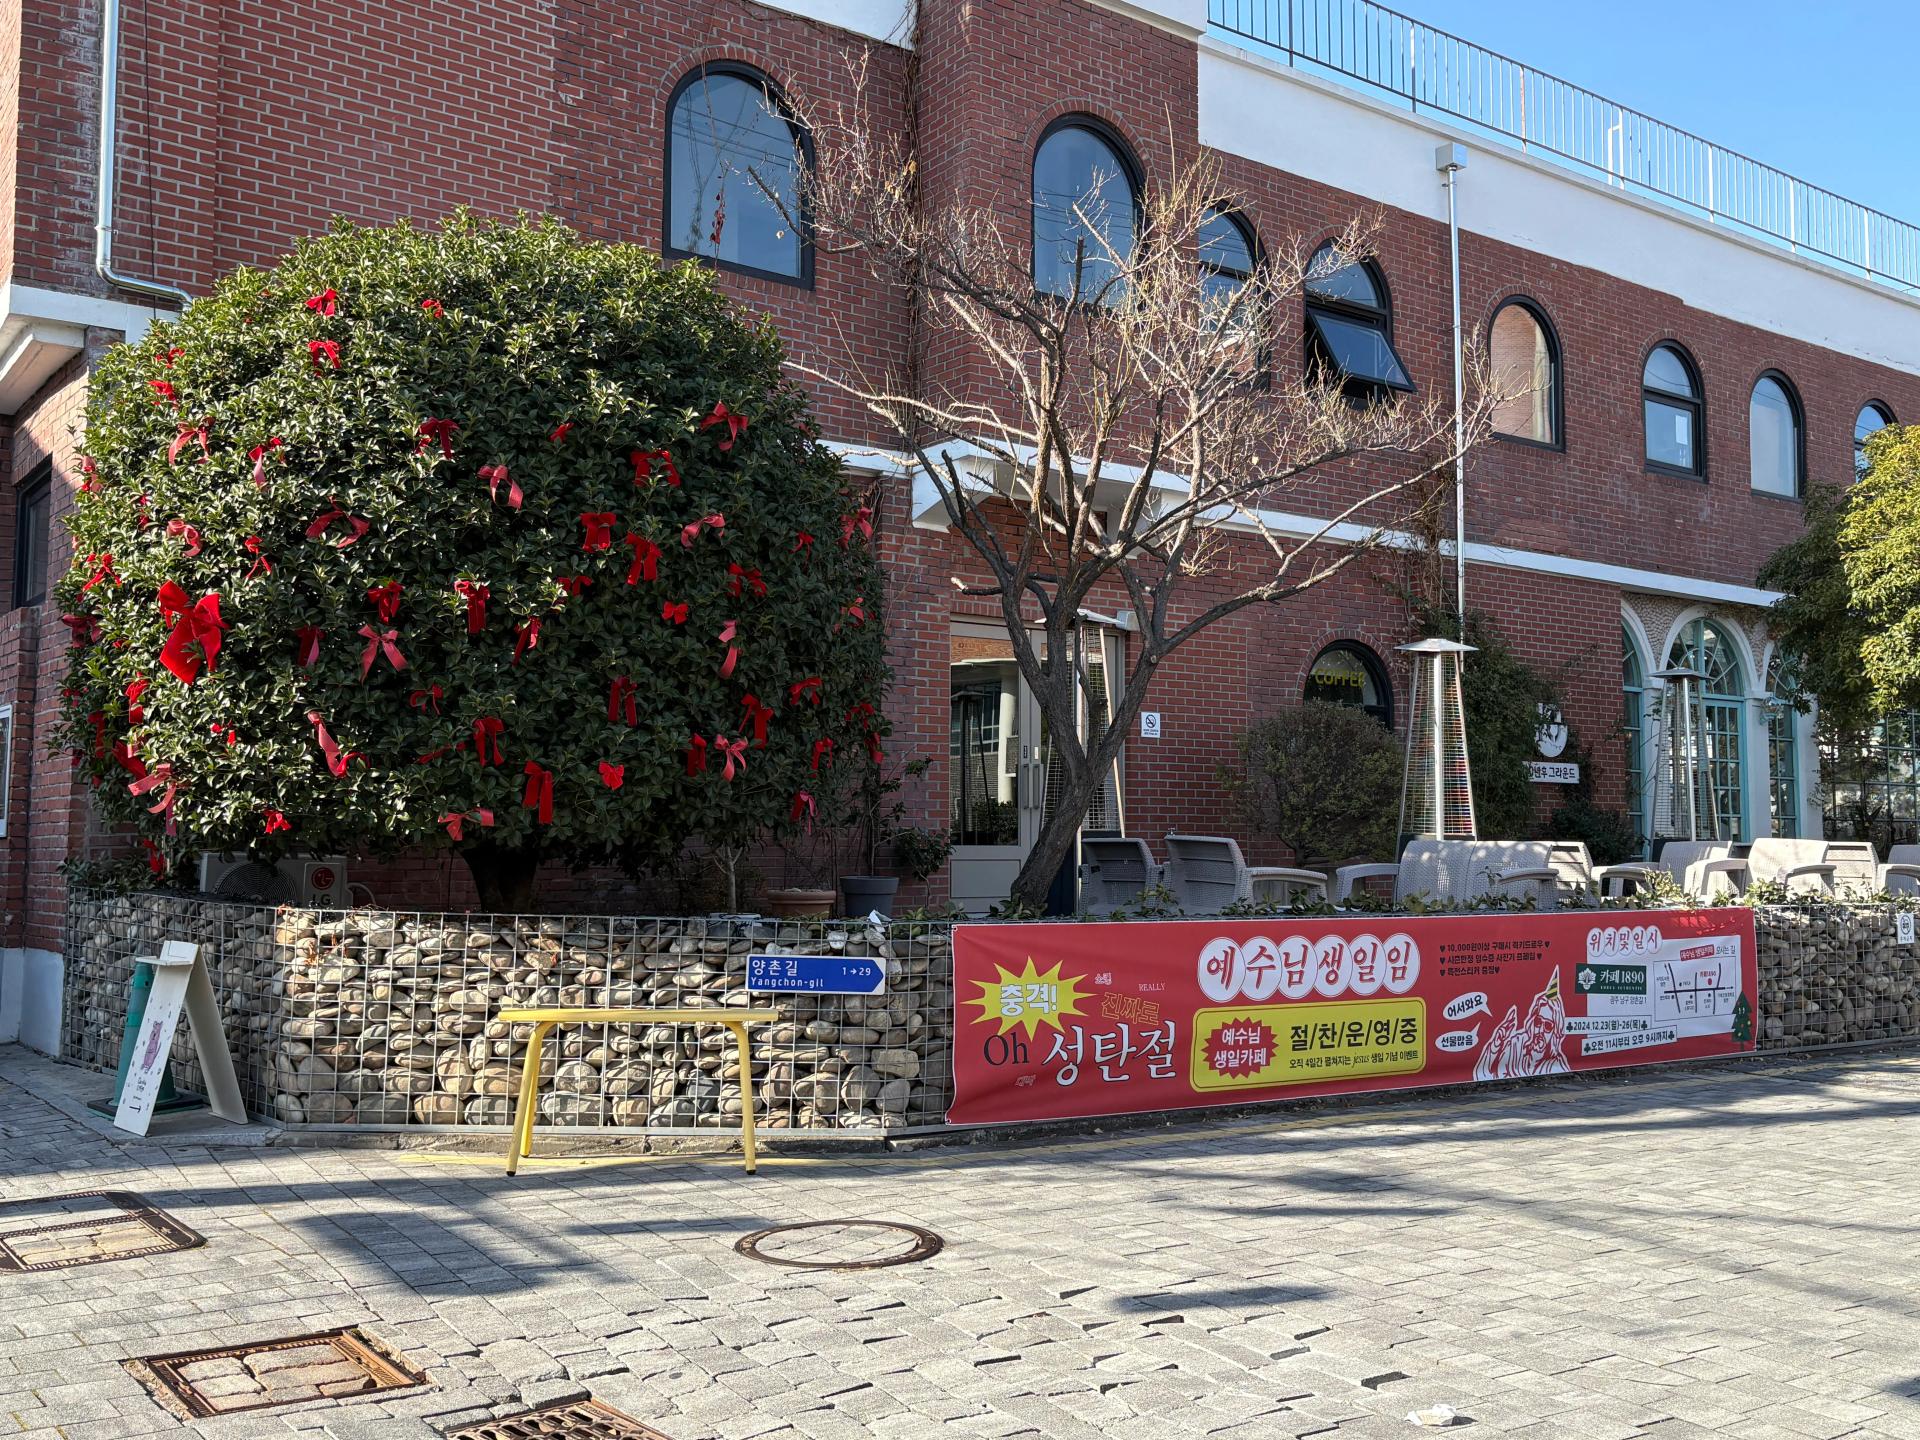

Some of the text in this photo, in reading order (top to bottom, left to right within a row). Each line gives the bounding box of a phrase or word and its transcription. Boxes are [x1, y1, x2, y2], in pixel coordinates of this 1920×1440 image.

[1589, 929, 1659, 953] 위치및일시
[752, 960, 797, 976] 양촌길
[1207, 941, 1410, 991] 예수님생일임
[751, 977, 824, 989] Yangchon-gil
[1138, 983, 1165, 991] REALLY
[1001, 983, 1057, 1017] 충격!
[1101, 991, 1160, 1026] 진짜로
[1447, 994, 1483, 1017] 어서와요
[1221, 1027, 1261, 1046] 예수님
[1290, 1017, 1418, 1052] 절/찬/운/영/중
[1441, 1035, 1474, 1048] 선물많음
[1591, 1041, 1604, 1052] 오전
[1632, 1034, 1644, 1044] 오후
[1646, 1031, 1668, 1043] 9시까지
[984, 1019, 1177, 1087] Oh 성탄절
[1214, 1047, 1267, 1068] 생일카페
[1289, 1058, 1303, 1068] 오직
[1305, 1057, 1323, 1068] 4일간
[1324, 1056, 1351, 1067] 펼쳐지는
[1371, 1053, 1384, 1063] 생일
[1385, 1051, 1398, 1062] 기념
[1399, 1050, 1419, 1060] 이벤트
